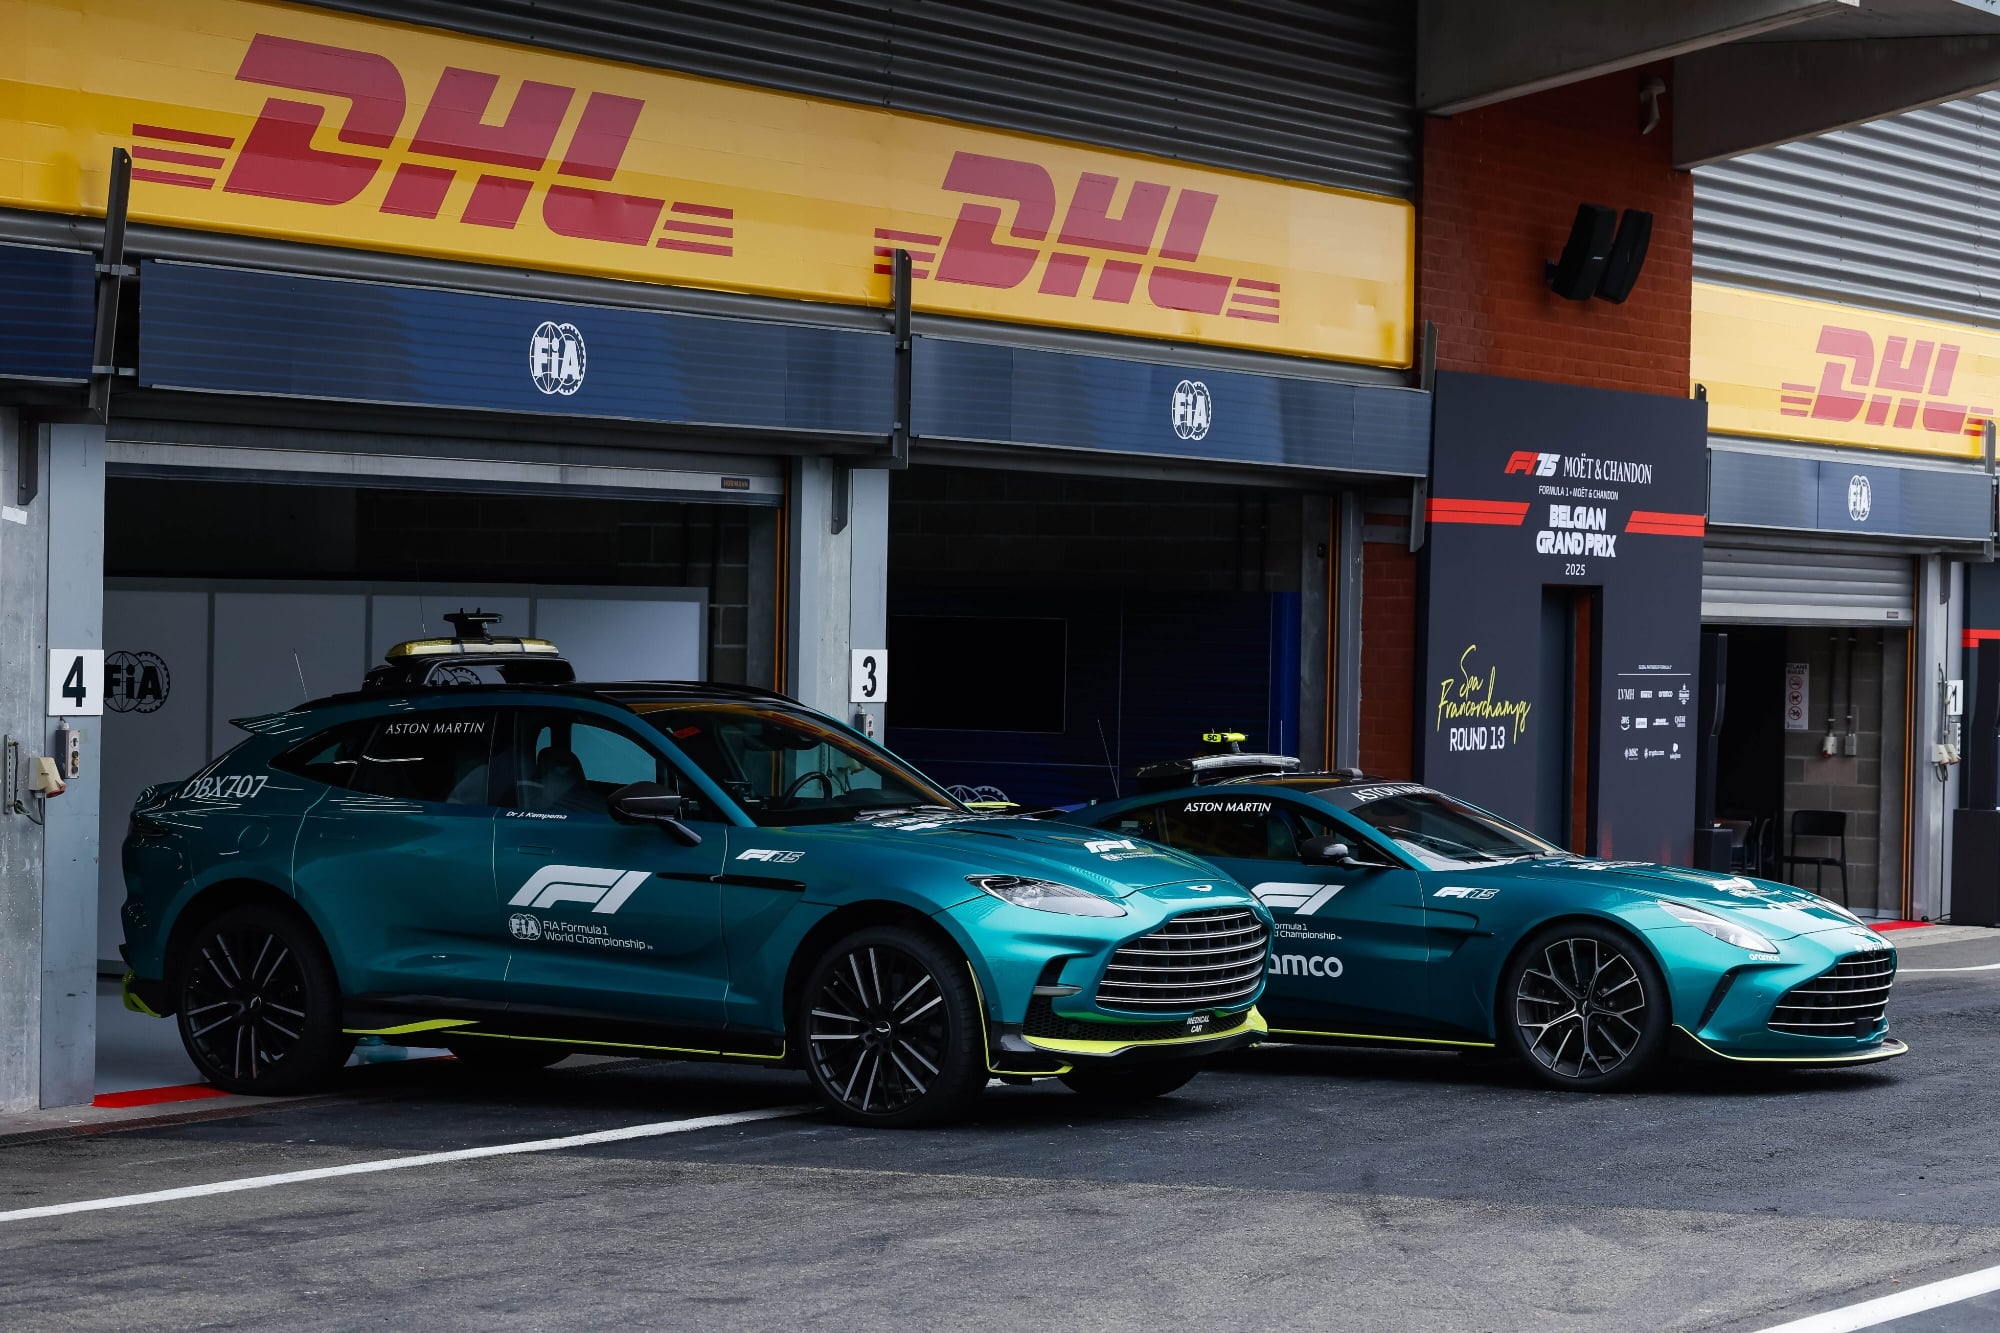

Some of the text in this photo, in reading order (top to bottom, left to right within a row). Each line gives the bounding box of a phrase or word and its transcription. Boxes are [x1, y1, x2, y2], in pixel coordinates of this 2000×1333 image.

[223, 33, 665, 247] DHL
[935, 151, 1233, 315] DHL
[1811, 325, 1968, 434] DHL
[1563, 452, 1594, 479] MOËT
[1594, 459, 1602, 480] &
[1603, 460, 1653, 485] CHANDON
[1538, 485, 1565, 497] FORMULA
[1565, 487, 1570, 497] 1
[1572, 487, 1588, 499] MOËT
[1593, 489, 1619, 501] CHANDON
[1549, 504, 1607, 531] BELGIAN
[1536, 530, 1617, 557] GRAND PRIX
[1565, 563, 1586, 576] 2025
[62, 655, 86, 708] 4
[862, 655, 877, 698] 3
[1459, 644, 1484, 702] Spa
[385, 722, 485, 735] ASTON MARTIN
[1207, 734, 1218, 742] SC
[1449, 726, 1506, 752] ROUND 13
[179, 774, 269, 799] DBX707
[1183, 802, 1272, 813] ASTON MARTIN
[507, 864, 653, 914] F1
[1250, 881, 1346, 916] F1
[543, 920, 609, 936] FIA Formula 1
[1274, 923, 1308, 931] ormula 1
[1279, 930, 1336, 940] Championship
[544, 930, 646, 951] World Championship
[1267, 953, 1344, 978] amco
[1749, 953, 1780, 962] aramco
[1186, 1014, 1210, 1025] MEDICAL
[1190, 1024, 1203, 1033] CAR
